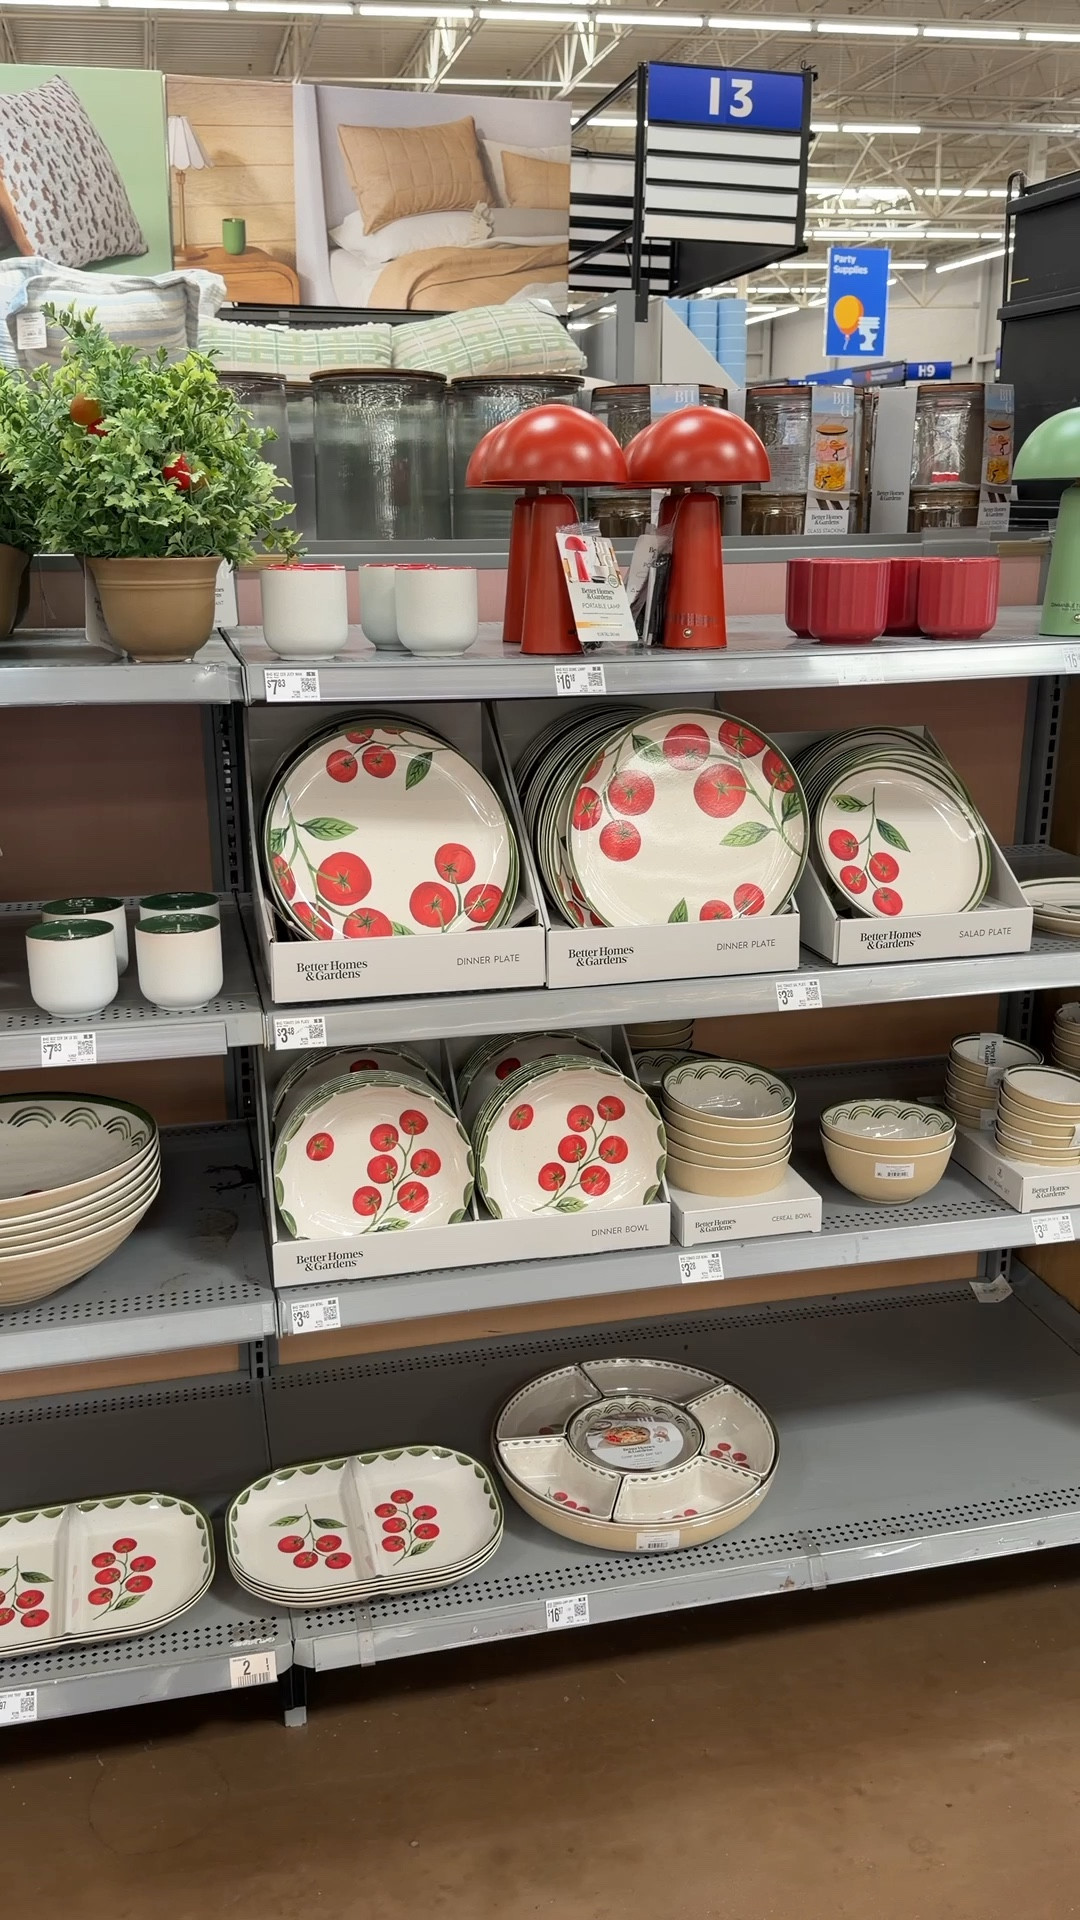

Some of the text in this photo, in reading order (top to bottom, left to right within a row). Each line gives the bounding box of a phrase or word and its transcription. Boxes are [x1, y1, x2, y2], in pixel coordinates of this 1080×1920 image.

[709, 77, 753, 118] 13
[834, 255, 856, 264] Party
[833, 265, 868, 275] Supplies
[919, 365, 935, 377] H9
[860, 931, 921, 941] Better Homes
[959, 929, 985, 938] SALAD
[717, 939, 775, 951] DINNER PLATE
[568, 946, 634, 959] Better Homes
[457, 954, 520, 966] DINNER PLATE
[297, 960, 368, 973] Better Homes
[592, 1224, 649, 1236] DINNER BOWL
[296, 1250, 363, 1265] Better Homes
[243, 1660, 251, 1675] 2
